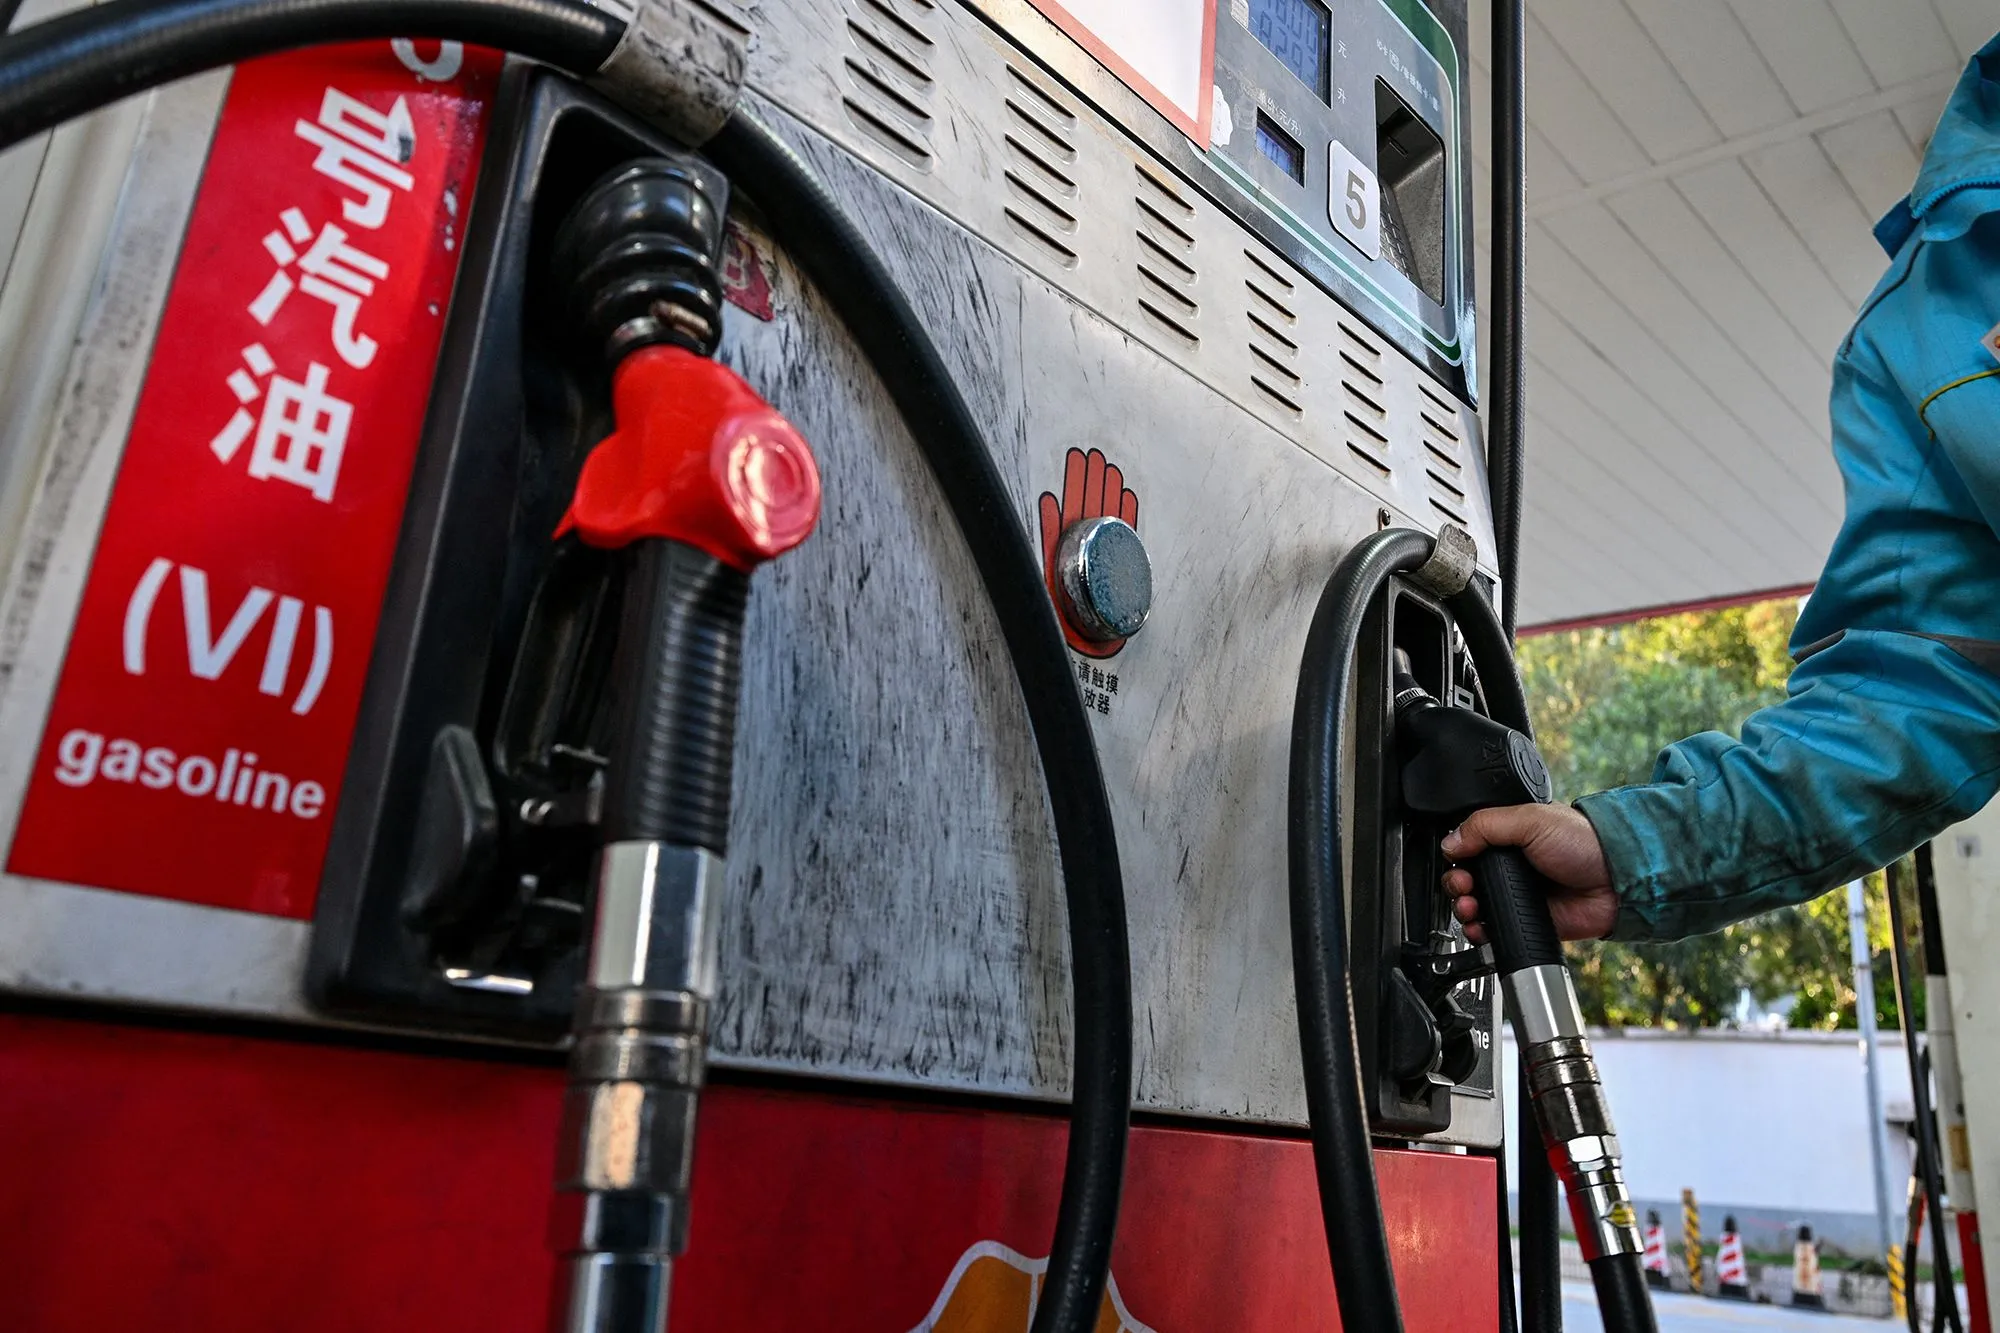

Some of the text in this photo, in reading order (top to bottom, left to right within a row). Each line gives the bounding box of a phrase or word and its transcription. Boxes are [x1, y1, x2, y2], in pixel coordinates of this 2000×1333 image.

[1338, 40, 1347, 58] 元
[1345, 169, 1366, 230] 5
[210, 86, 416, 502] 号汽油
[123, 556, 334, 716] (VI)
[1071, 658, 1119, 696] 请触摸
[1083, 687, 1110, 715] 放器
[55, 728, 326, 819] gasoline
